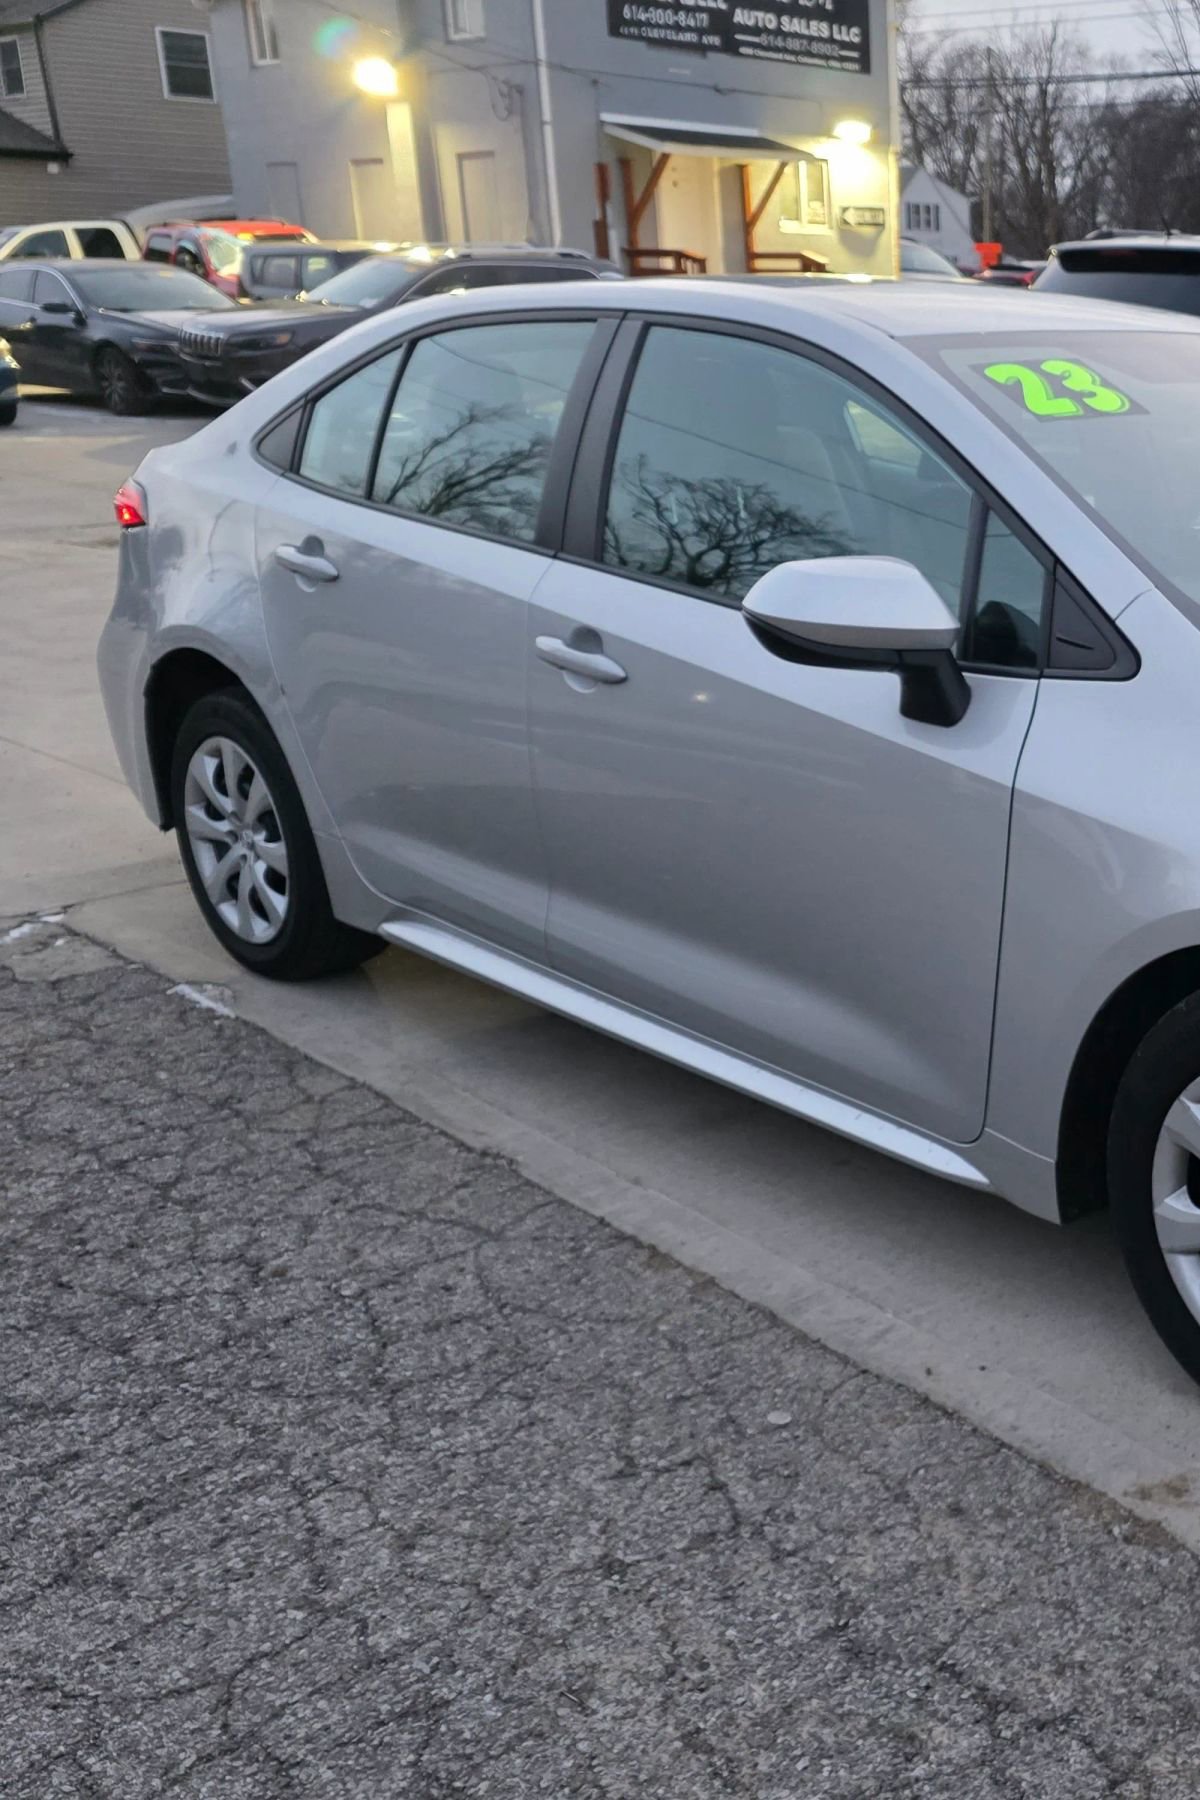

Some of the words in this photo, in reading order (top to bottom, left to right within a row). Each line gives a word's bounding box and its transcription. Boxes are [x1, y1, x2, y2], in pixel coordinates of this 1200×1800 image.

[733, 7, 778, 30] AUTO
[780, 15, 830, 38] SALES
[832, 23, 861, 43] LLC
[983, 359, 1131, 417] 23
